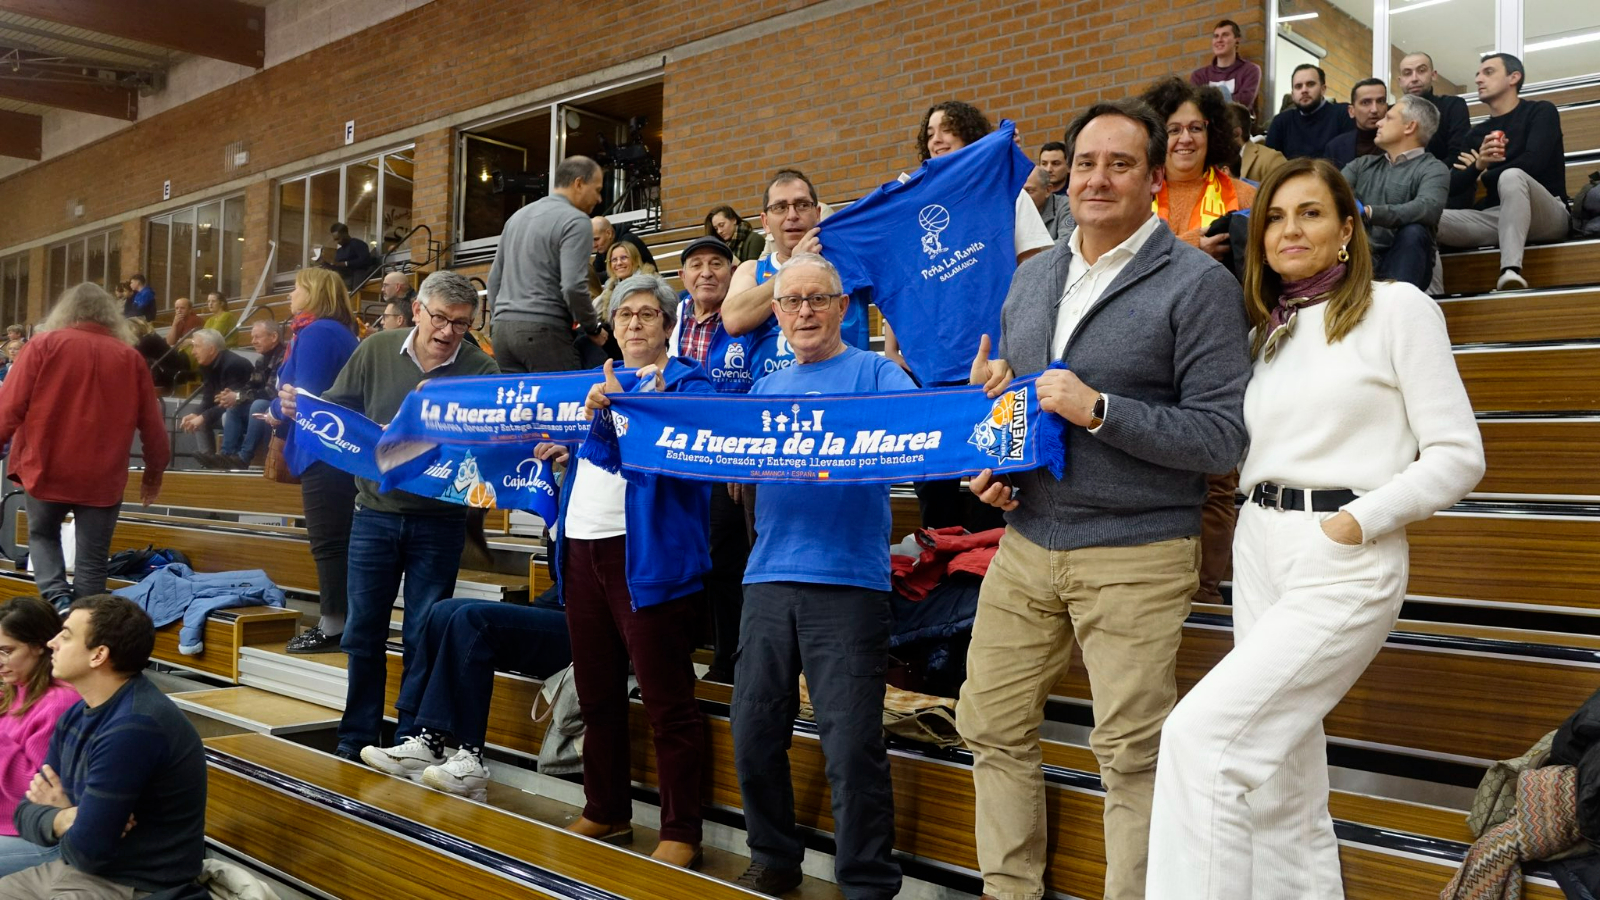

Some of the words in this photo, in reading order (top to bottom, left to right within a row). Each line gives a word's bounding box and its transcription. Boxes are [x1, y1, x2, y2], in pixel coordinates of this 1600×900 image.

[346, 125, 353, 140] F
[164, 184, 170, 197] E
[921, 265, 945, 280] Peña
[942, 258, 957, 268] La
[954, 241, 985, 260] Ranita
[939, 257, 978, 282] SALAMANCA
[296, 411, 317, 433] Caja
[420, 399, 441, 421] La
[444, 402, 505, 423] Fuerza
[510, 403, 534, 423] de
[536, 403, 553, 422] la
[565, 424, 576, 432] por
[1010, 390, 1026, 459] AVENIDA
[656, 426, 688, 450] La
[691, 429, 771, 455] Fuerza
[784, 431, 815, 455] de
[818, 432, 845, 455] la
[849, 429, 942, 455] Marea
[666, 450, 713, 465] Esfuerzo,
[715, 455, 755, 466] Corazón
[758, 459, 764, 467] y
[767, 457, 807, 468] Entrega
[809, 457, 856, 467] llevamos
[859, 456, 877, 467] por
[880, 454, 924, 464] bandera
[502, 474, 526, 491] Caja
[516, 457, 554, 496] Duero
